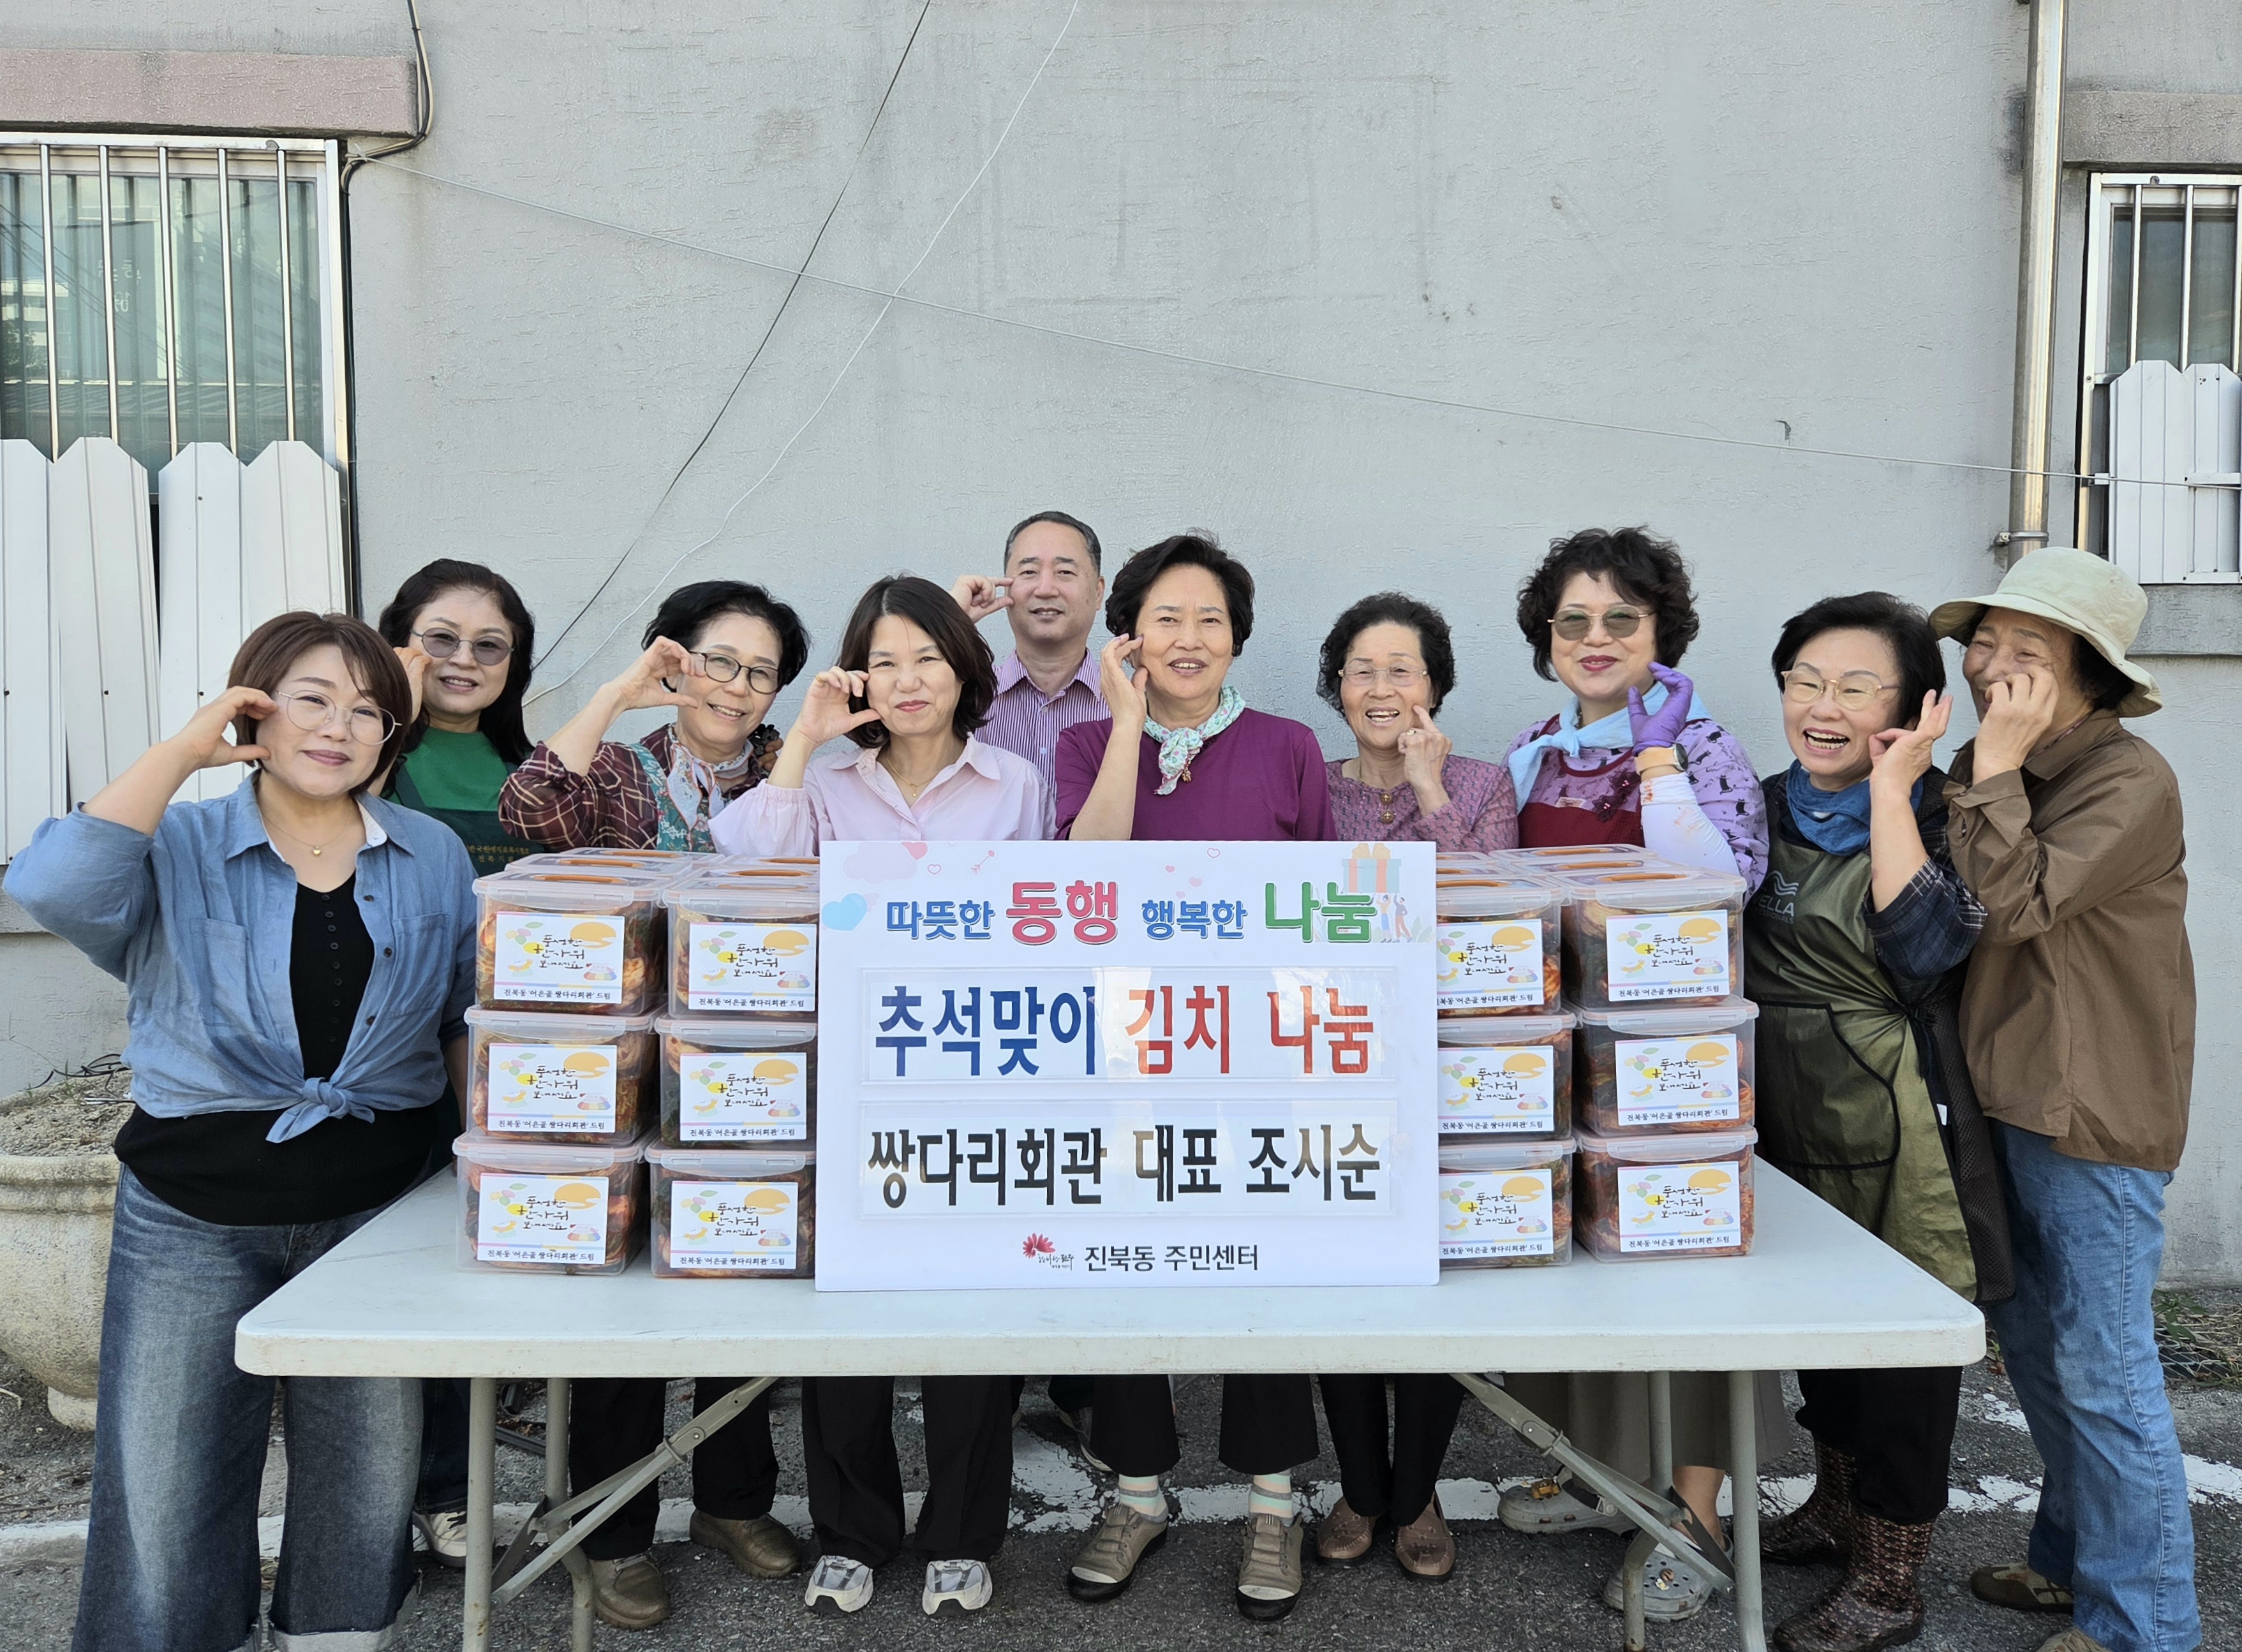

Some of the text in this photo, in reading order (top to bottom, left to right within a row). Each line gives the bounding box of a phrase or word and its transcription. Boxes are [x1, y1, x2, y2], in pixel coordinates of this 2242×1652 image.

[887, 880, 1377, 945] 따뜻한 동행 행복한 나눔
[542, 934, 583, 948] 풍성한
[1652, 933, 1690, 947] 풍성한
[533, 943, 584, 959] 한가위
[736, 943, 775, 956] 풍성한
[1466, 941, 1504, 954] 풍성한
[1644, 941, 1693, 958] 한가위
[727, 953, 778, 968] 한가위
[1458, 950, 1506, 966] 한가위
[504, 988, 527, 996] 진북동
[1619, 989, 1640, 997] 진북동
[876, 986, 1373, 1077] 추석맞이 김치 나눔
[1659, 1056, 1698, 1070] 풍성한
[535, 1065, 575, 1078] 풍성한
[1477, 1067, 1515, 1080] 풍성한
[1652, 1066, 1700, 1082] 한가위
[526, 1075, 578, 1089] 한가위
[726, 1073, 765, 1086] 풍성한
[1469, 1077, 1517, 1091] 한가위
[718, 1082, 768, 1097] 한가위
[498, 1119, 521, 1128] 진북동
[1627, 1112, 1649, 1121] 진북동
[690, 1128, 713, 1137] 진북동
[868, 1124, 1379, 1208] 쌍다리회관 대표 조시순
[1476, 1191, 1514, 1204] 풍성한
[1662, 1184, 1700, 1197] 풍성한
[526, 1195, 567, 1209] 풍성한
[1467, 1200, 1517, 1216] 한가위
[1654, 1193, 1703, 1209] 한가위
[517, 1205, 568, 1220] 한가위
[716, 1202, 756, 1215] 풍성한
[708, 1212, 759, 1226] 한가위
[1629, 1239, 1651, 1248] 진북동
[487, 1250, 510, 1258] 진북동
[1085, 1245, 1258, 1271] 진북동 주민센터
[1443, 1247, 1464, 1255] 진북동
